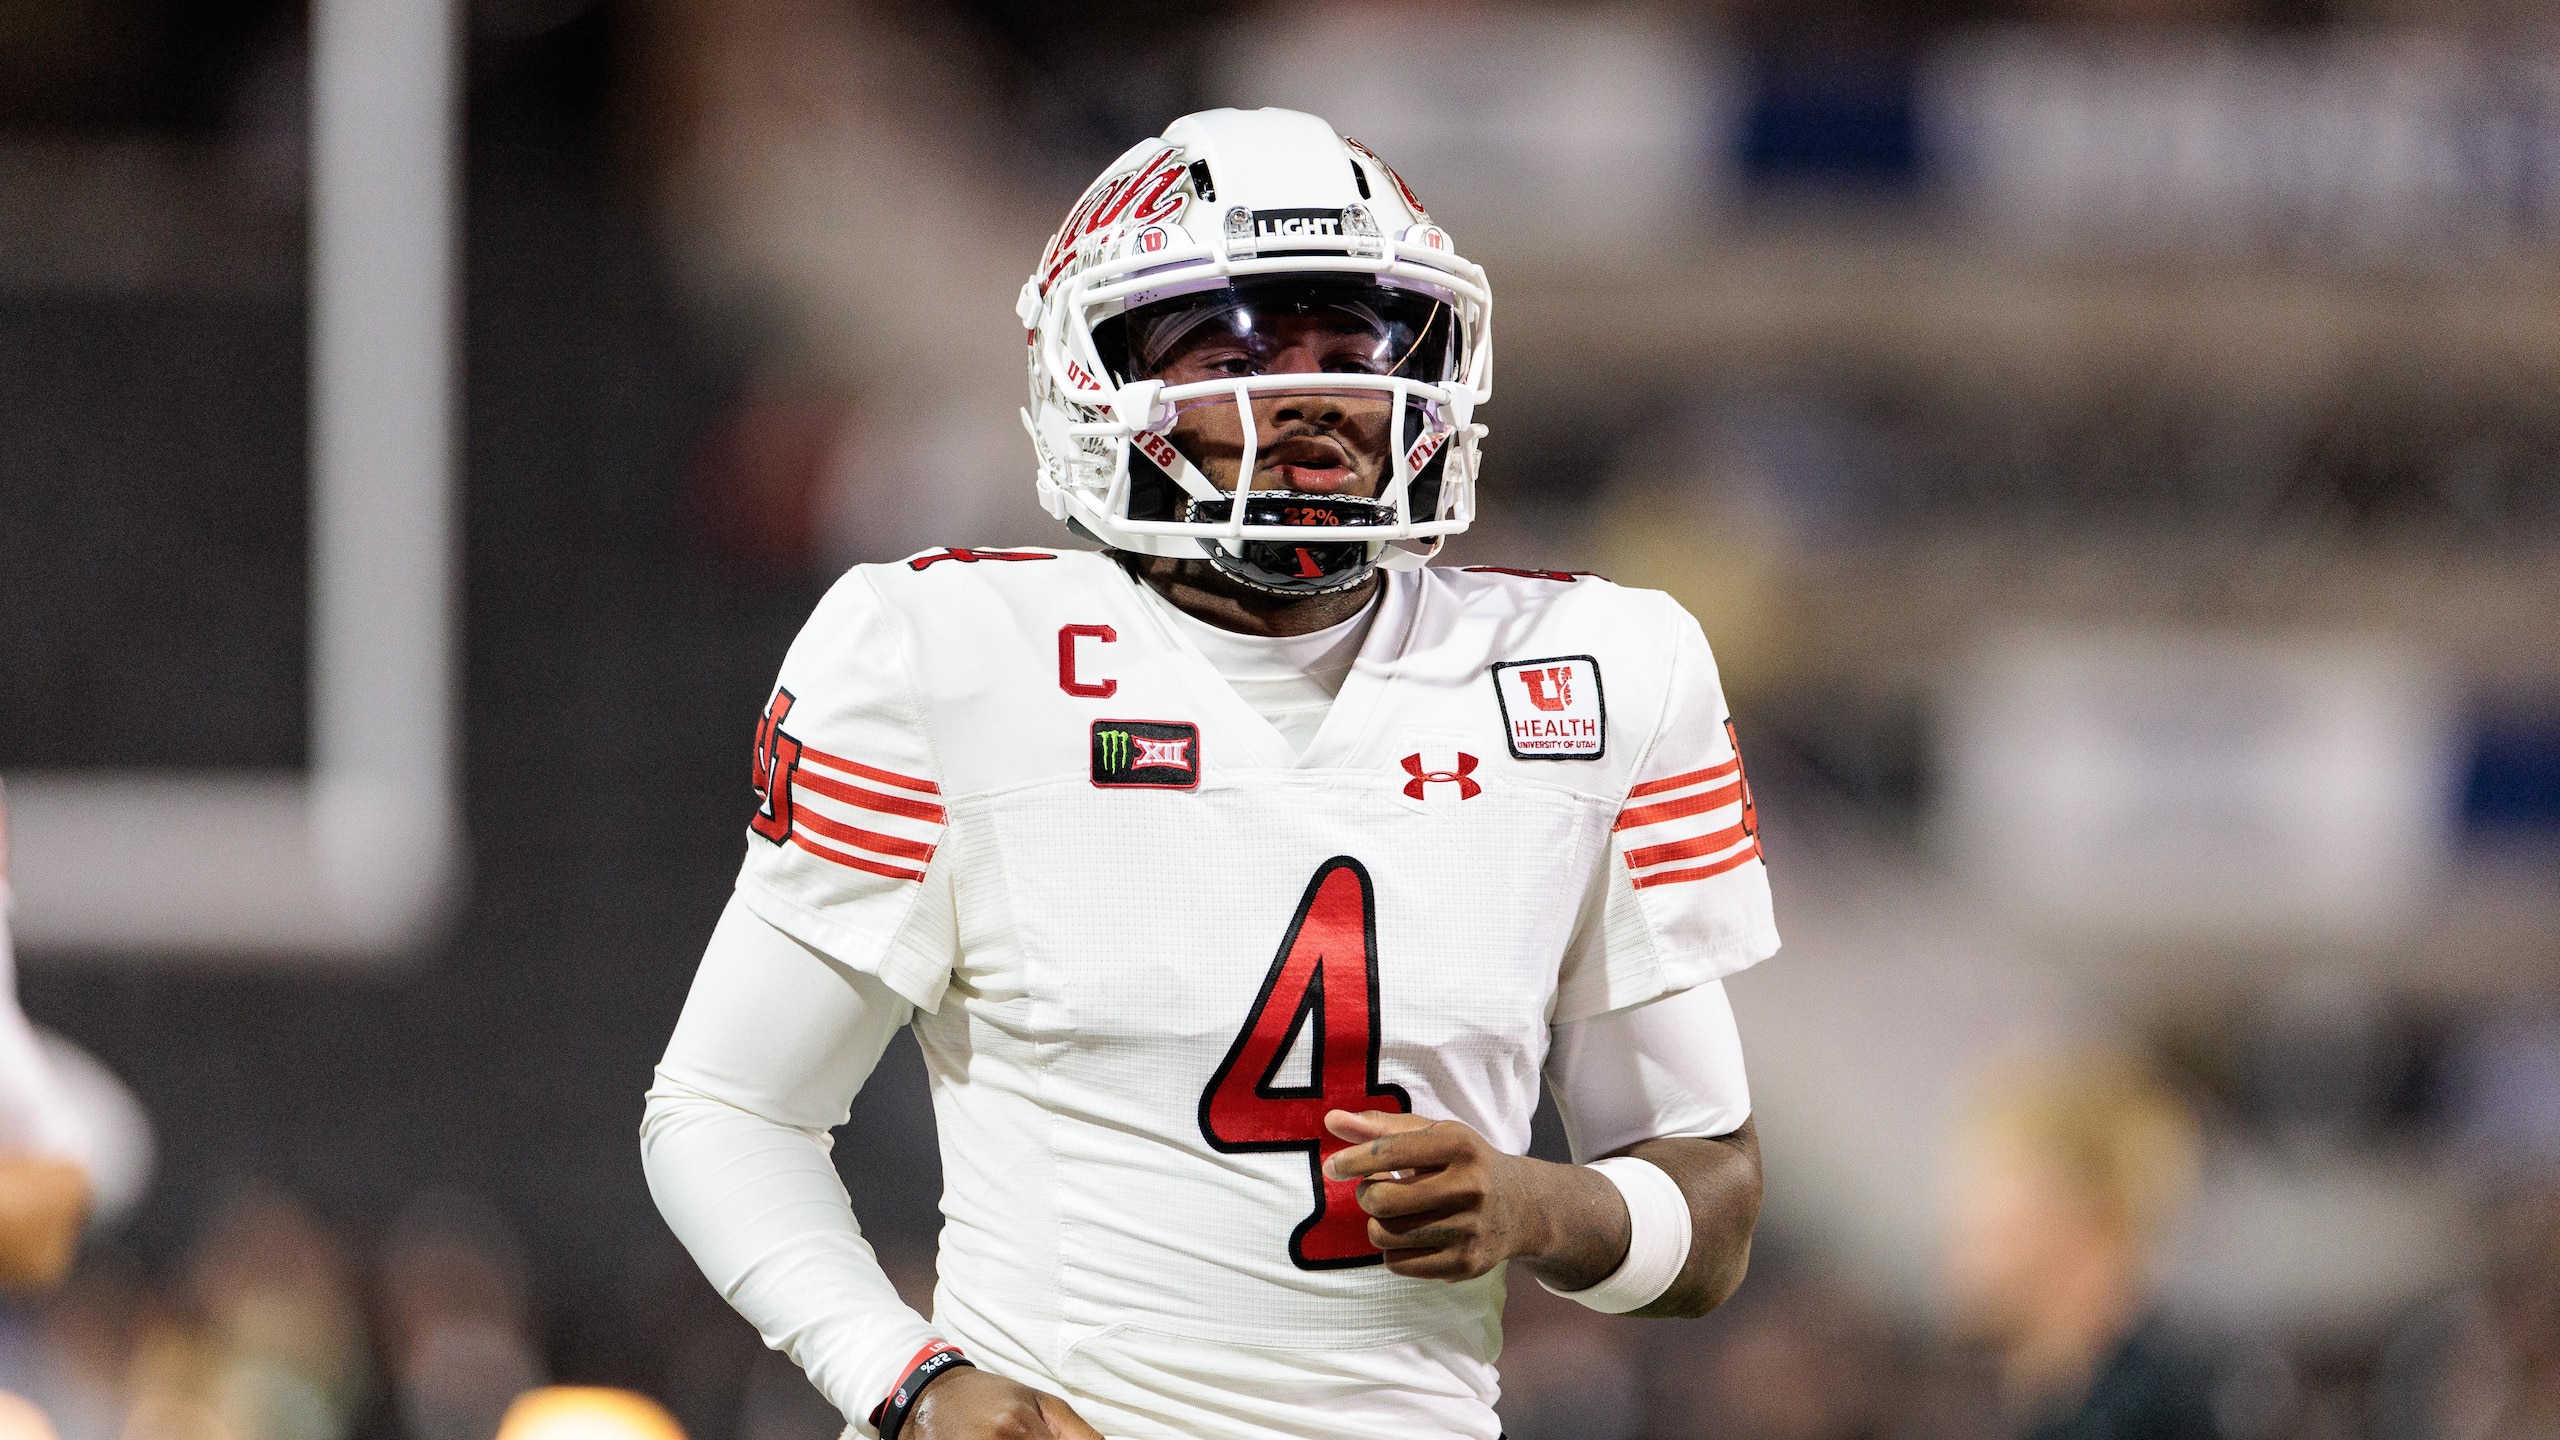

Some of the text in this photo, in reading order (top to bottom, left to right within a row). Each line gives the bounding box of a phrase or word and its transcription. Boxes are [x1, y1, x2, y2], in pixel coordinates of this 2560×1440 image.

[1258, 217, 1338, 237] LIGHT
[1144, 232, 1162, 253] U
[1284, 507, 1340, 527] 22%
[1058, 623, 1118, 699] C
[1515, 718, 1596, 737] HEALTH
[1133, 738, 1191, 770] XII
[1517, 740, 1597, 749] UNIVERSITY OF UTAH
[1198, 855, 1412, 1271] 4
[920, 1352, 952, 1374] 22%
